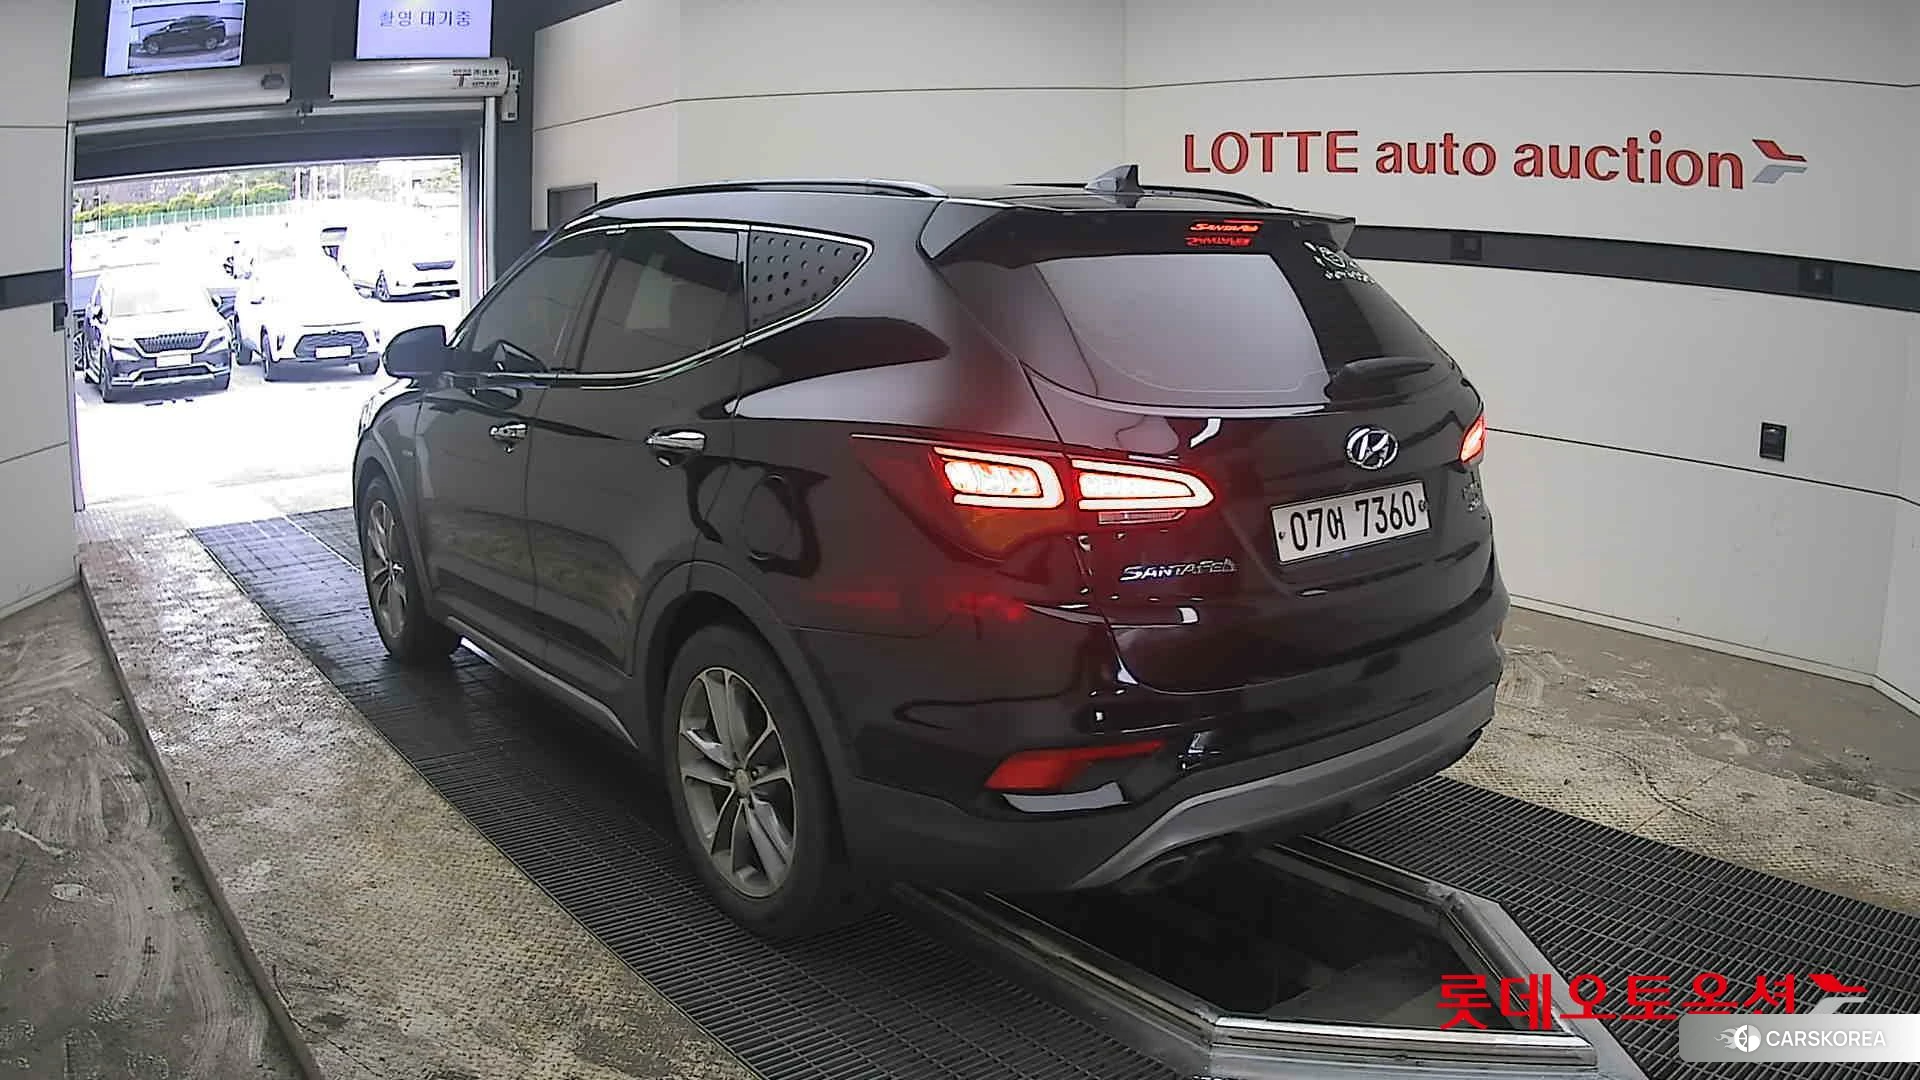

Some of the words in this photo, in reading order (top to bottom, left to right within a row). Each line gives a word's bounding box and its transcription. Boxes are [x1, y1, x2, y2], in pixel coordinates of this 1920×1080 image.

[420, 10, 471, 27] 대기중
[1184, 130, 1359, 175] LOTTE
[1375, 132, 1498, 177] auto
[1512, 129, 1744, 190] auction
[1289, 506, 1347, 552] 07어
[1354, 490, 1417, 537] 7360
